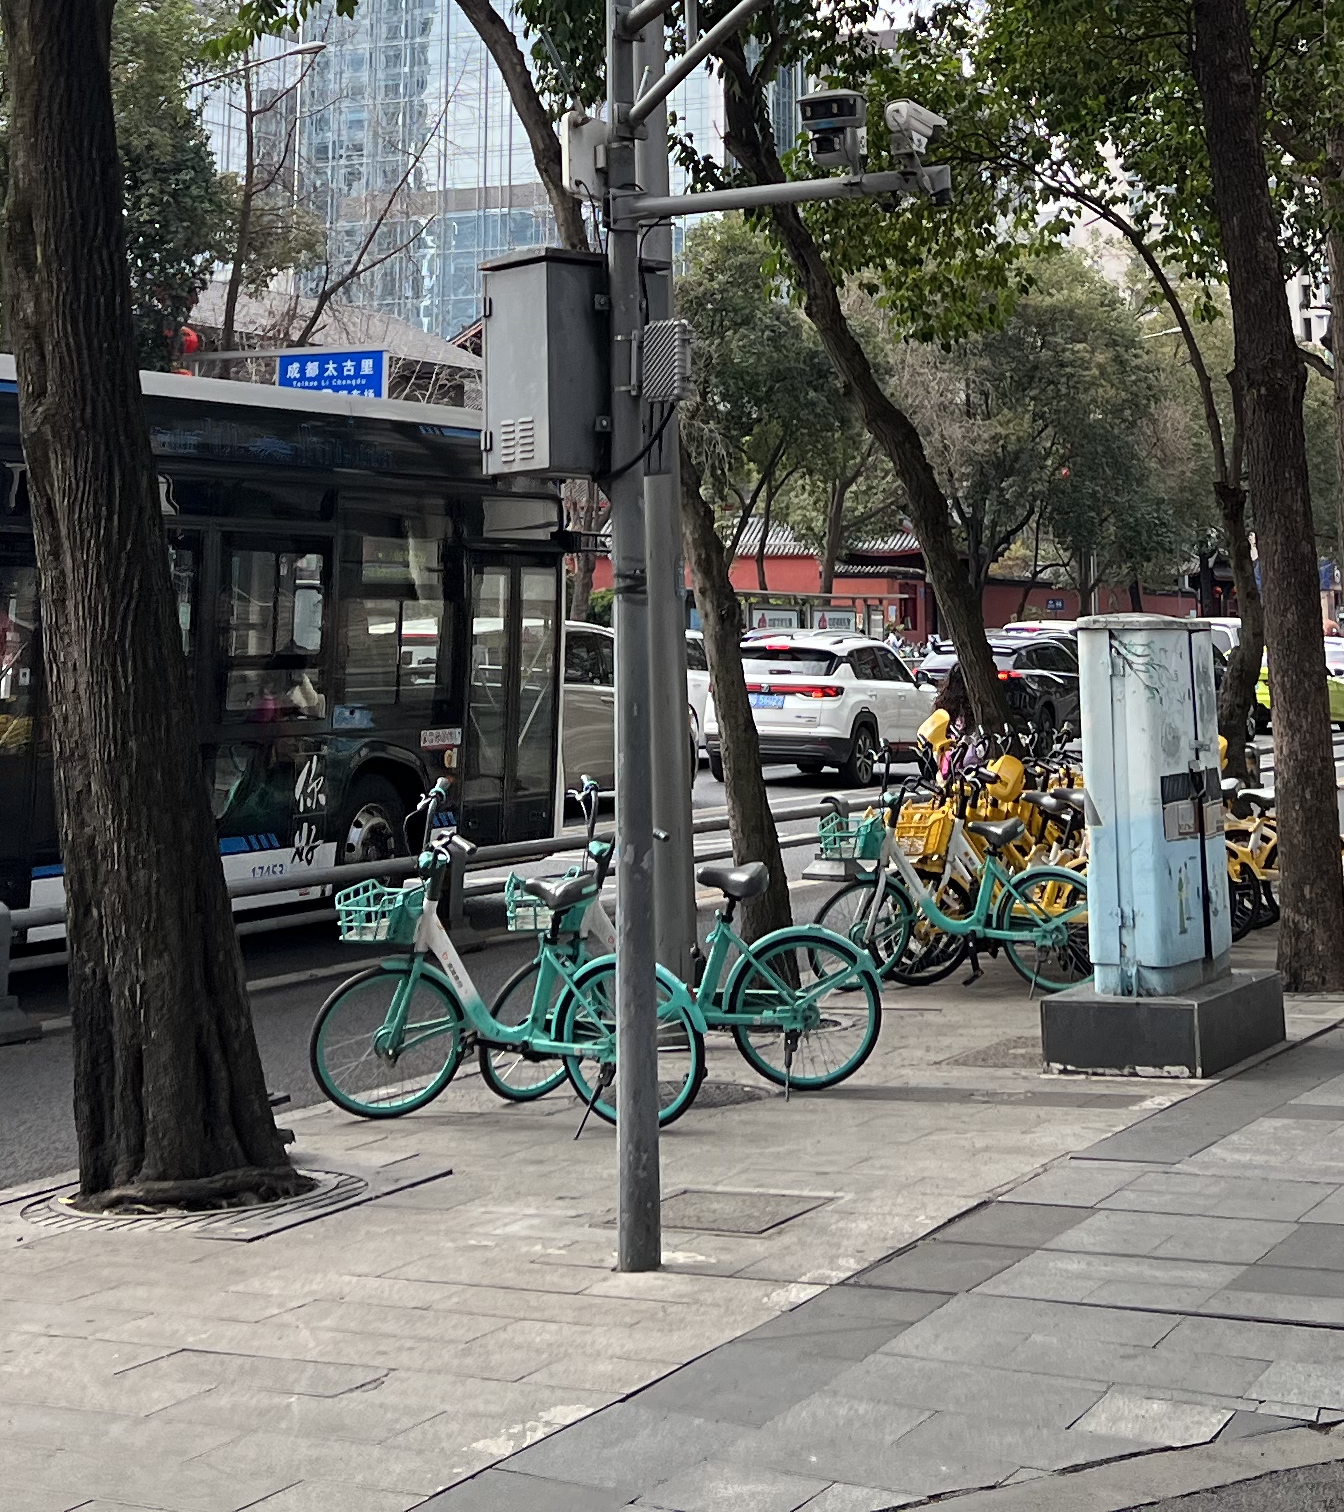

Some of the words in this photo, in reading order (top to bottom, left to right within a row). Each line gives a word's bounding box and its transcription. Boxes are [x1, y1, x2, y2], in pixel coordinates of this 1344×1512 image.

[286, 358, 374, 379] 成都太古里
